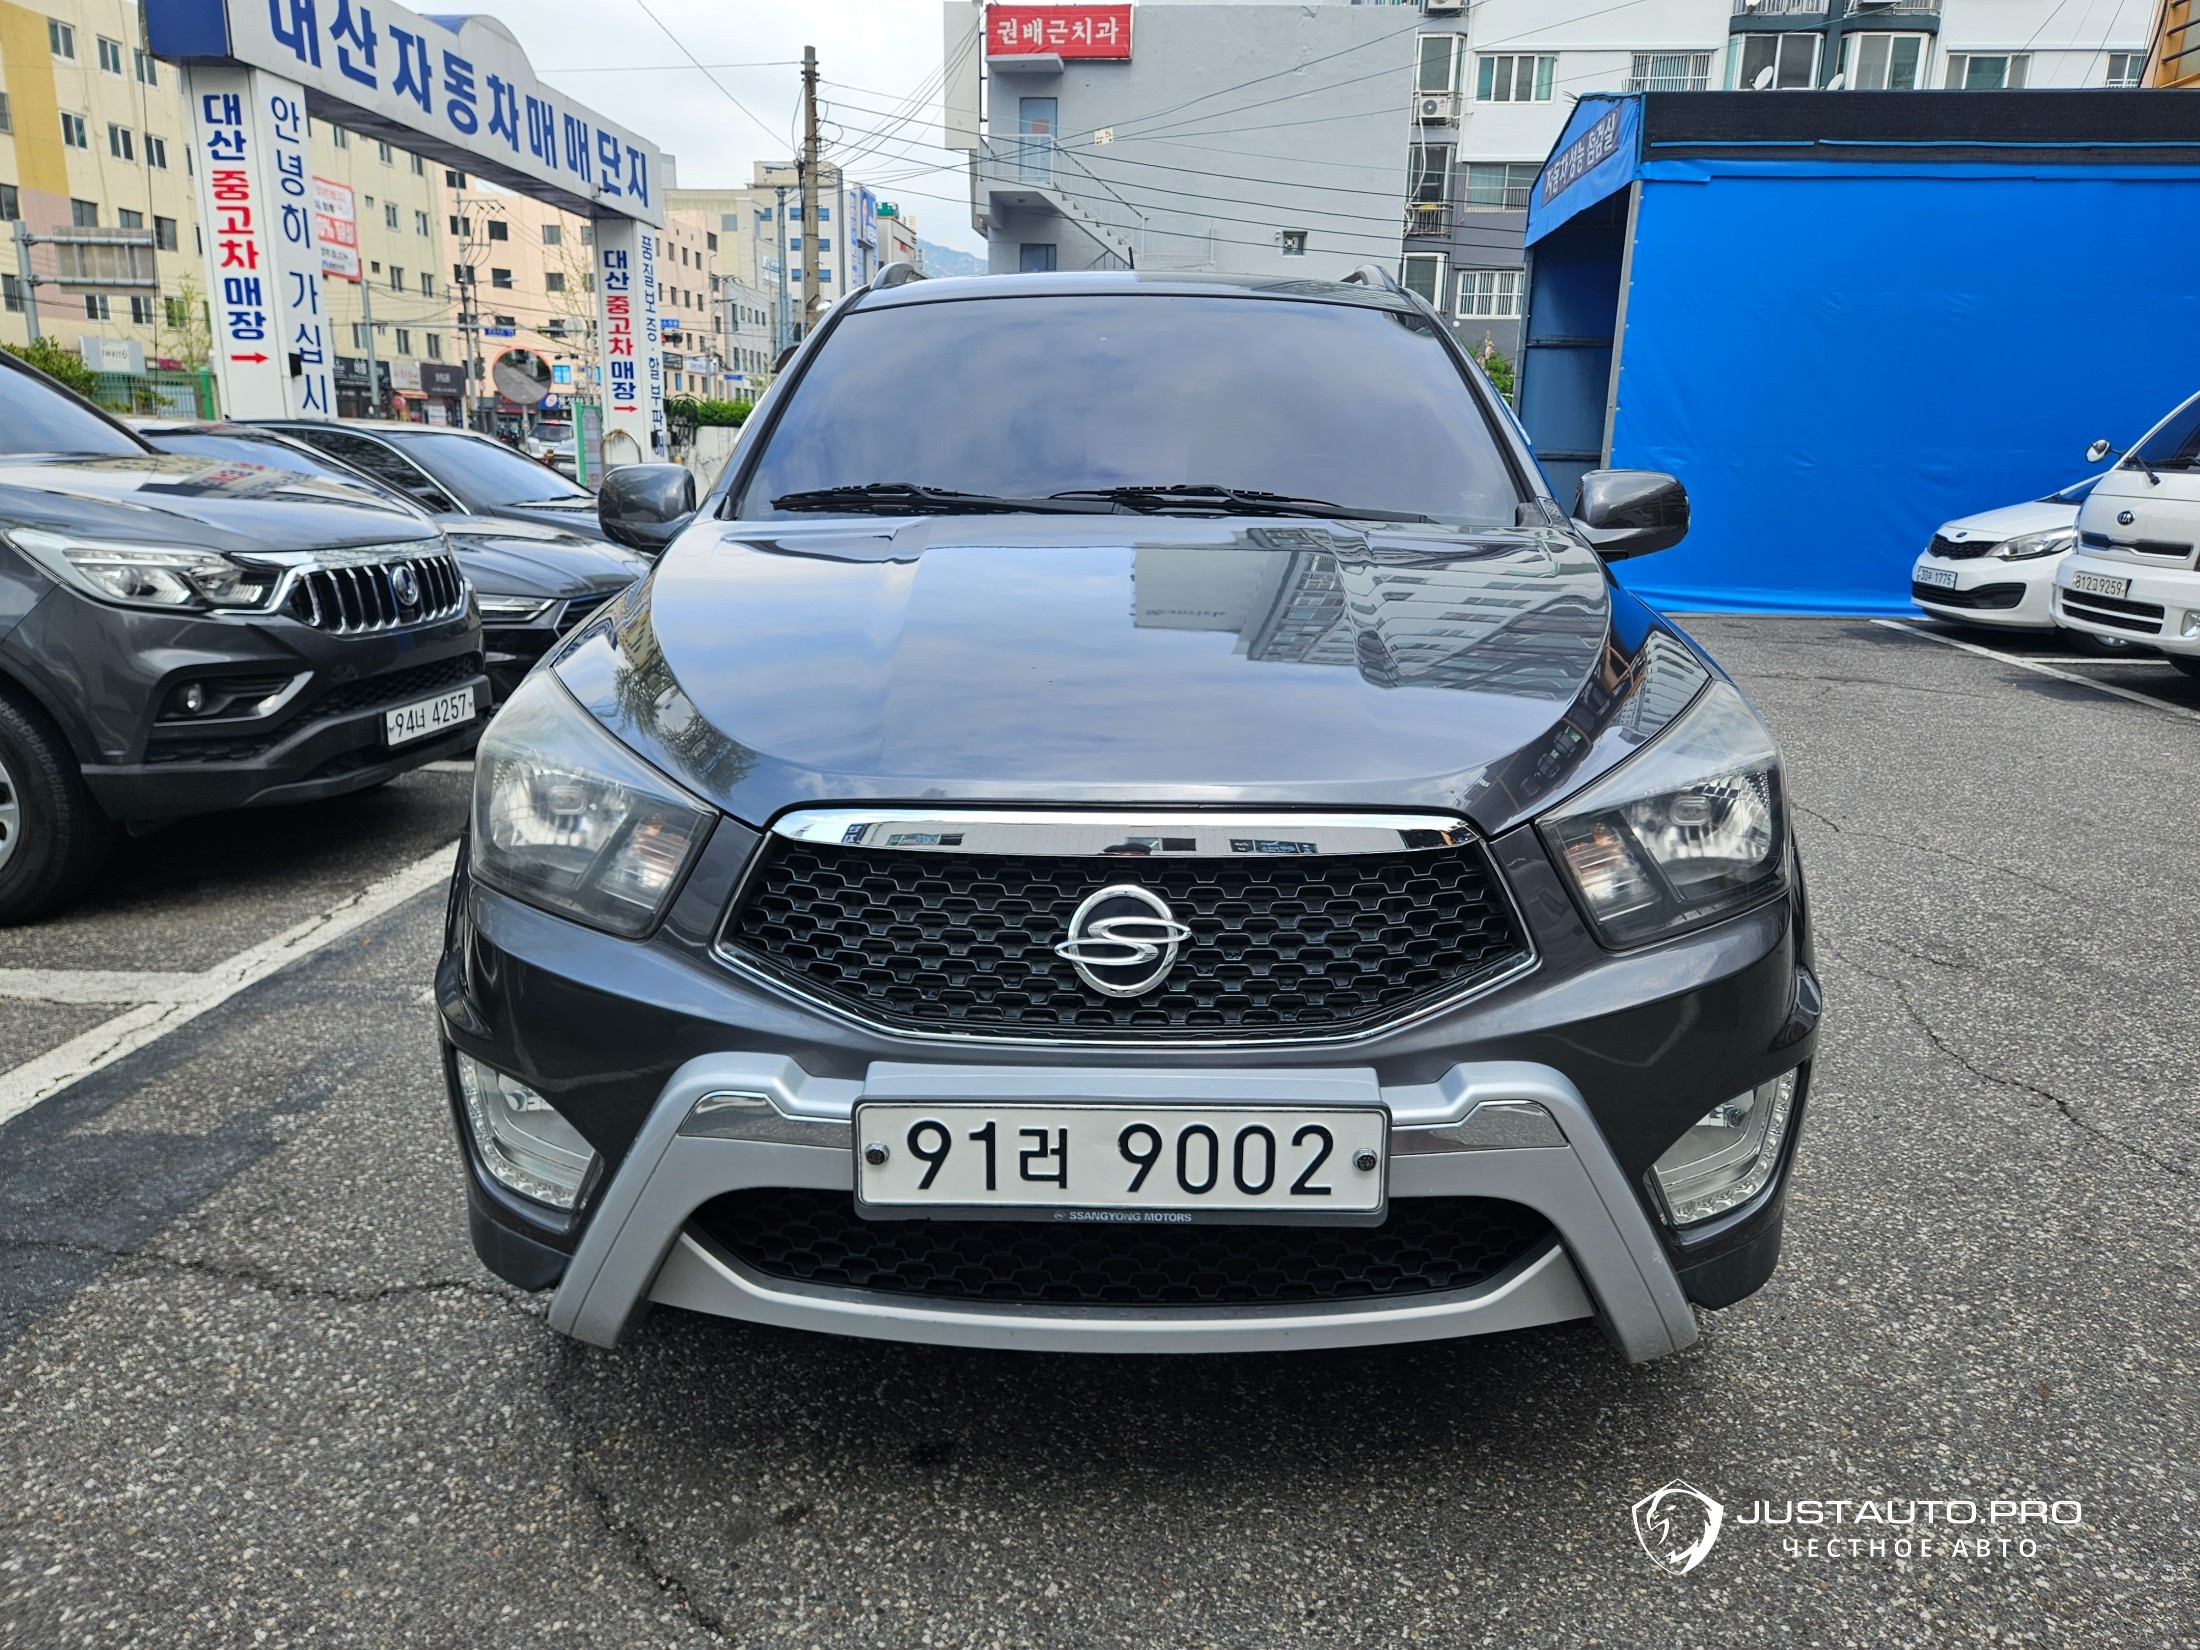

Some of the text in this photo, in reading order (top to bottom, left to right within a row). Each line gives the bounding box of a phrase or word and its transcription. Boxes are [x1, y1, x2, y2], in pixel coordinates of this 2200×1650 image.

[997, 16, 1119, 46] 권배근치과
[1587, 112, 1616, 166] 점검실
[271, 96, 310, 249] 안녕히
[1935, 571, 1952, 585] 1775
[432, 693, 466, 725] 4257
[907, 1120, 1334, 1196] 91러 9002
[1069, 1211, 1192, 1222] SSANGYONG MOTORS
